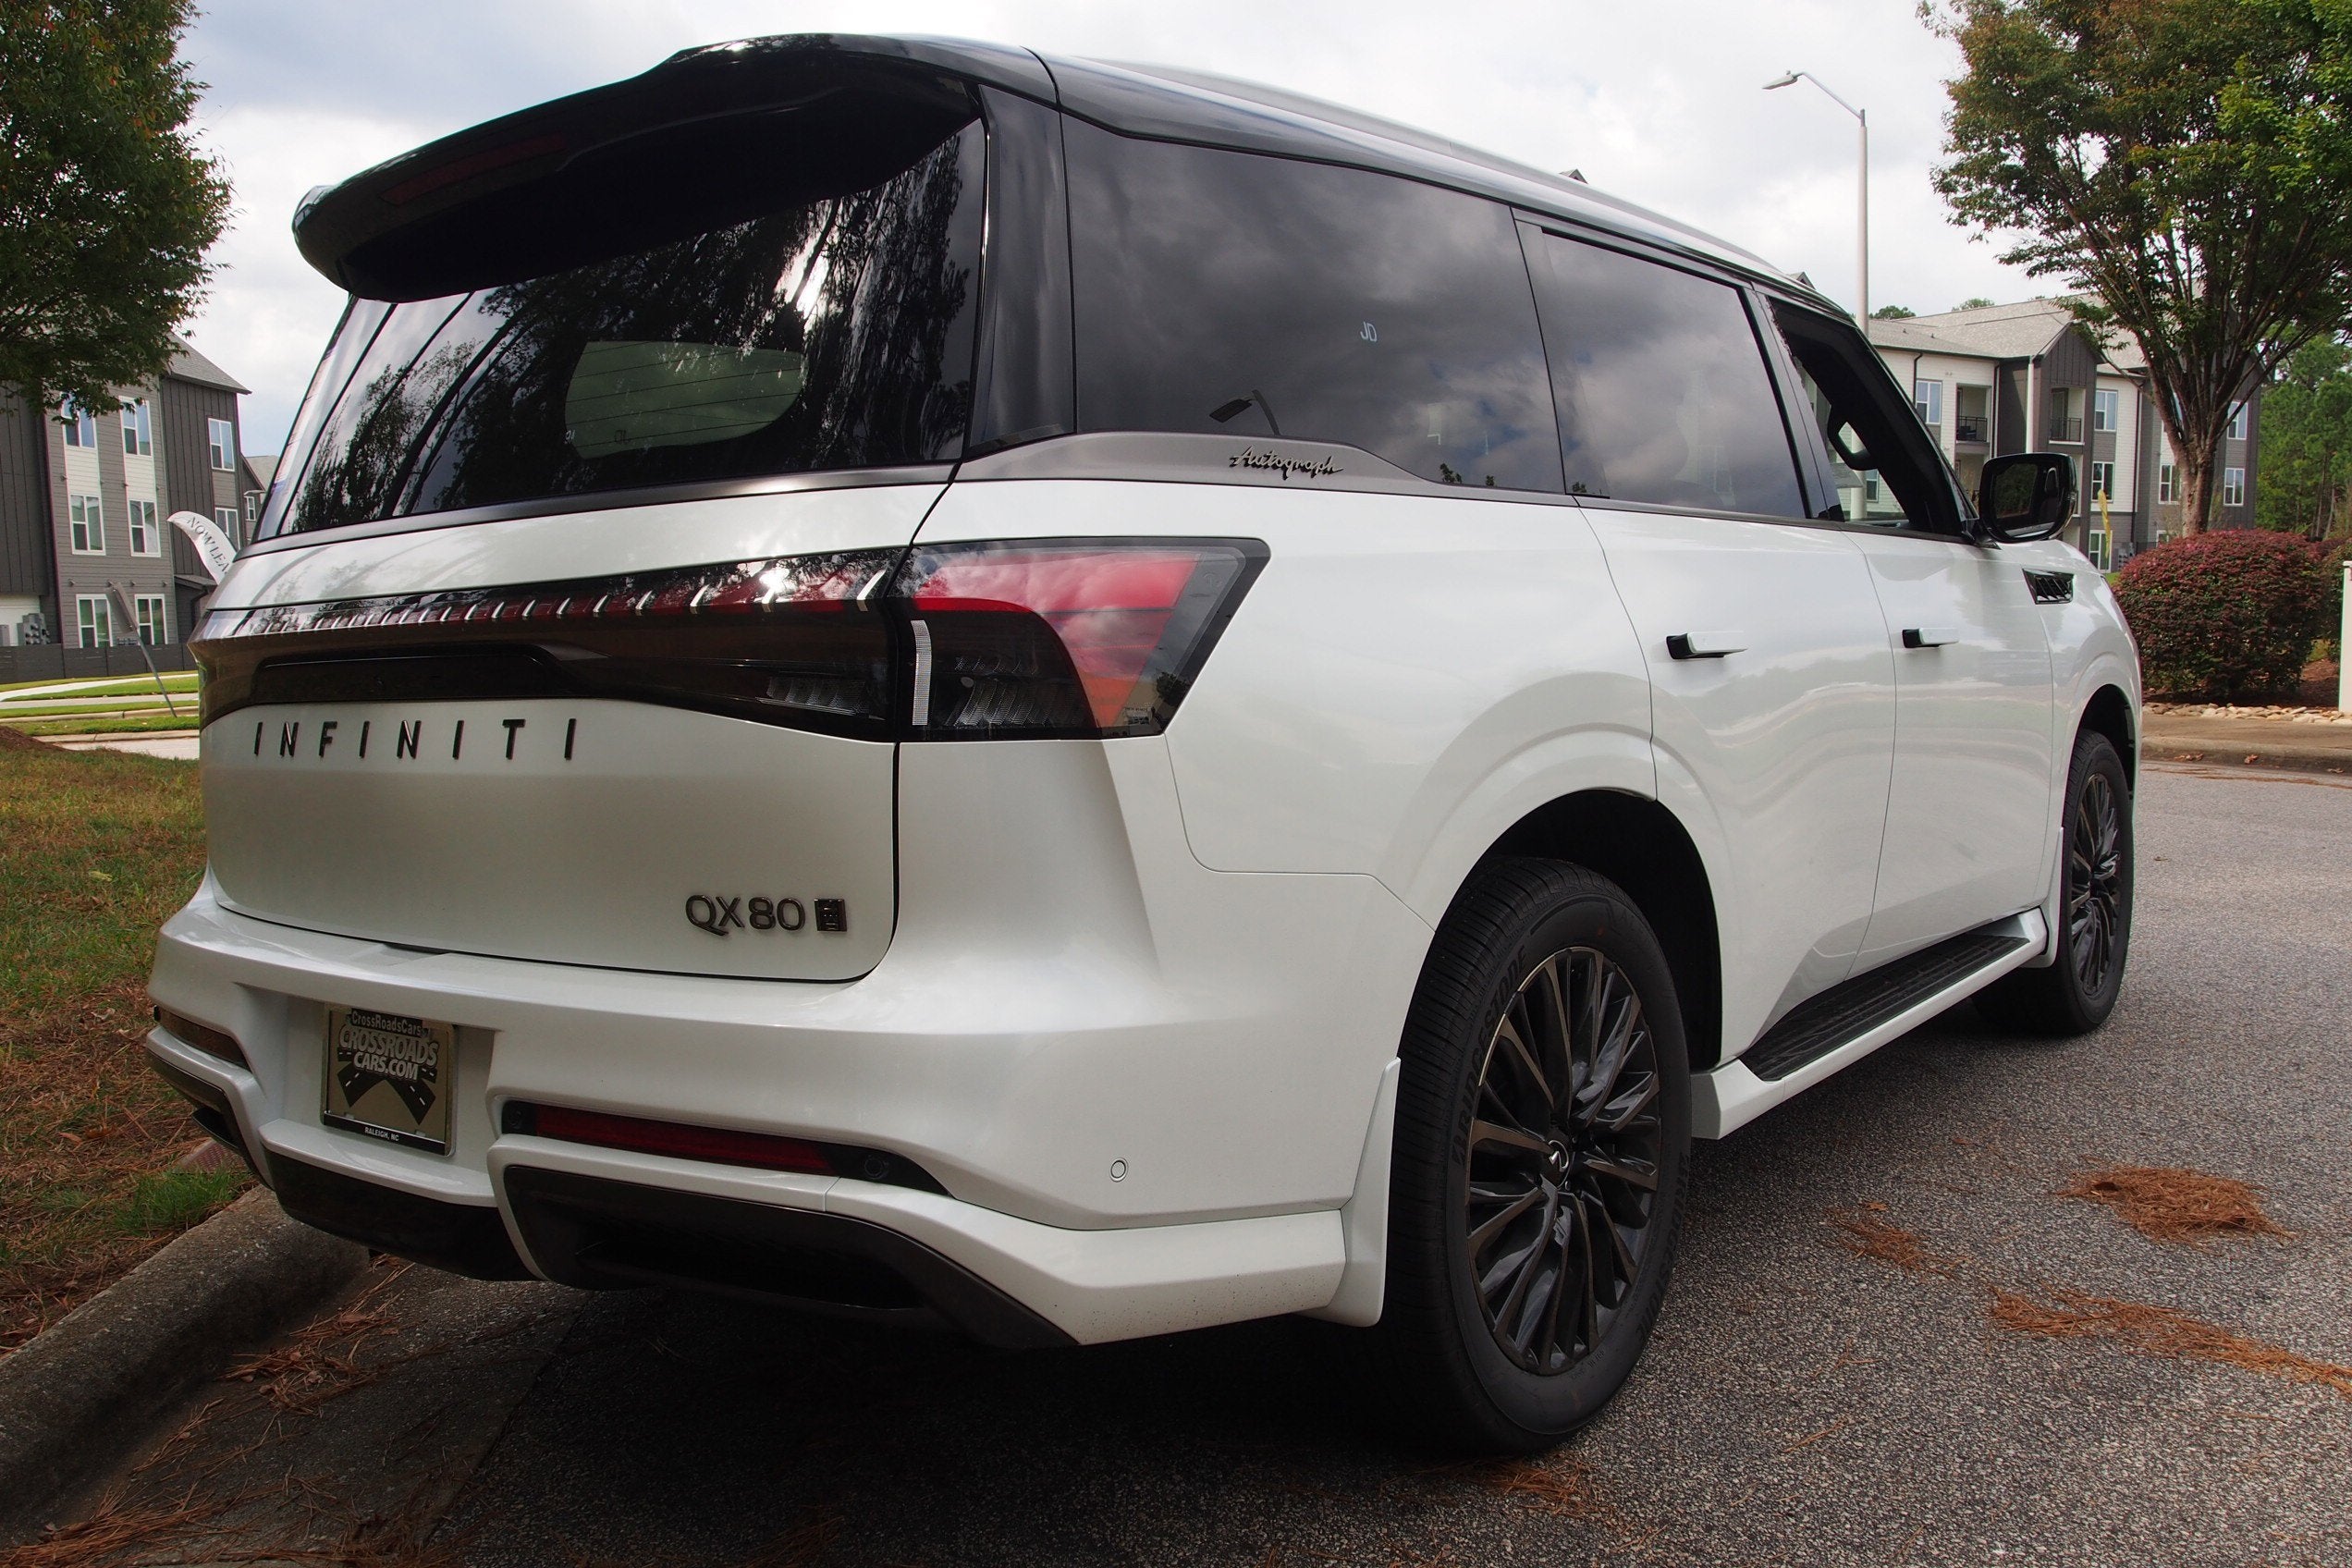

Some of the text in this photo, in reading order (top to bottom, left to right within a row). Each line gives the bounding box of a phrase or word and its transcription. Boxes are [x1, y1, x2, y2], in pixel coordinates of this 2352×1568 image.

[1230, 446, 1343, 480] Autograph
[187, 517, 229, 573] NOW LEA
[253, 717, 577, 761] INFINITI
[685, 894, 806, 937] QX80
[339, 1024, 439, 1067] CROSSROADS
[353, 1051, 420, 1081] CARS.COM
[1452, 944, 1526, 1166] BRIDGESTONE
[364, 1126, 399, 1142] RALEIGH, NC
